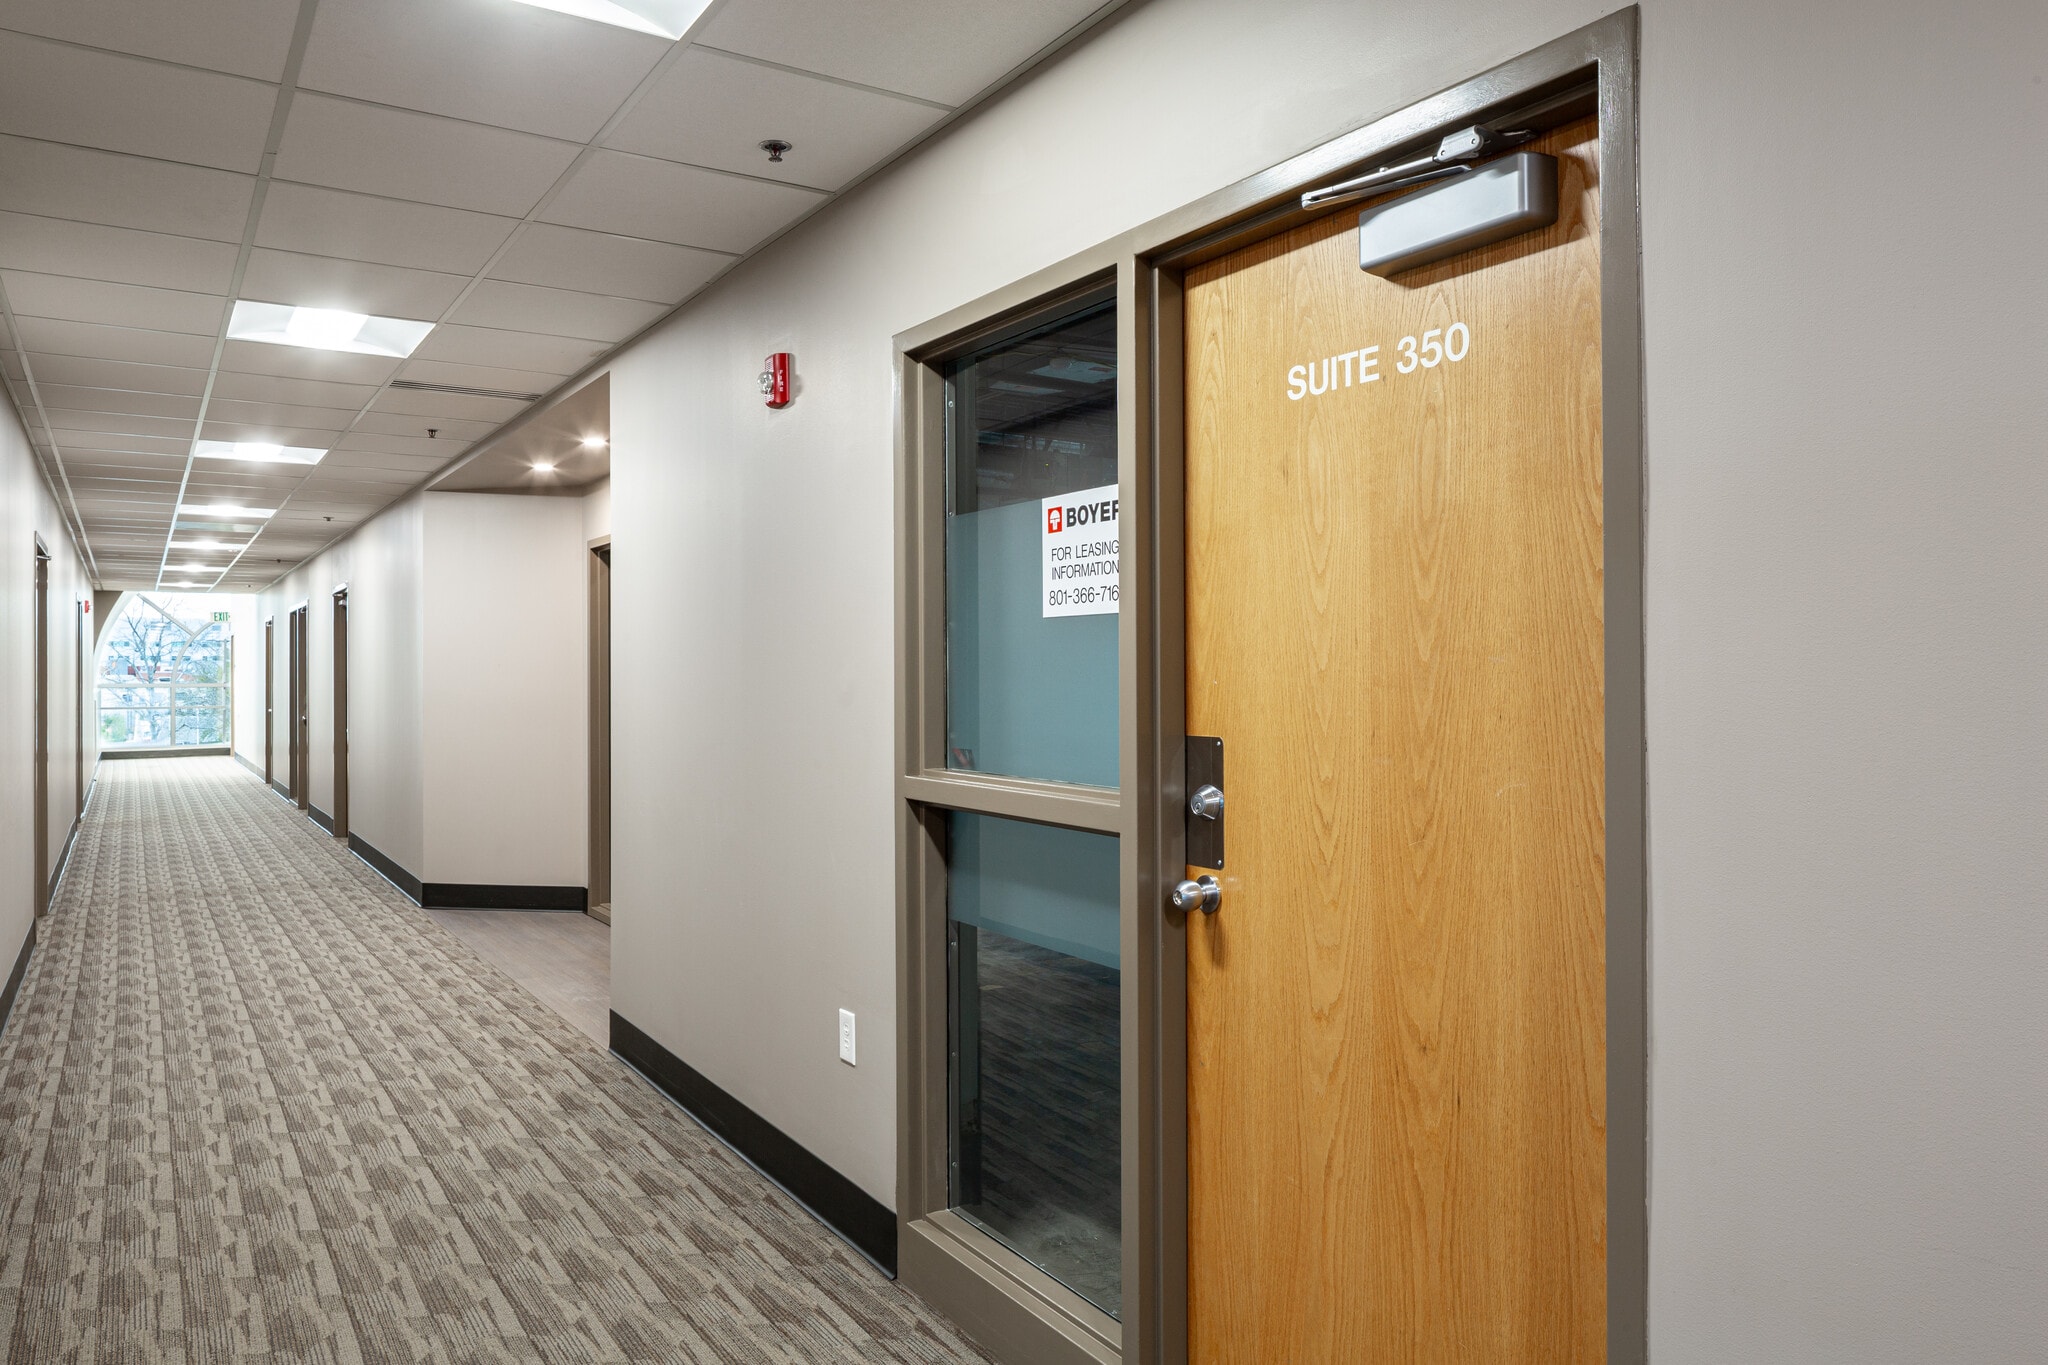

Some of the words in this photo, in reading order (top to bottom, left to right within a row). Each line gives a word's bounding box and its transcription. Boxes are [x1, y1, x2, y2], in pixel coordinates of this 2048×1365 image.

[1286, 344, 1380, 401] SUITE
[1396, 321, 1470, 374] 350
[1051, 546, 1072, 561] FOR
[1076, 540, 1119, 559] LEASING
[1051, 560, 1119, 581] INFORMATION
[213, 611, 229, 622] EXIT
